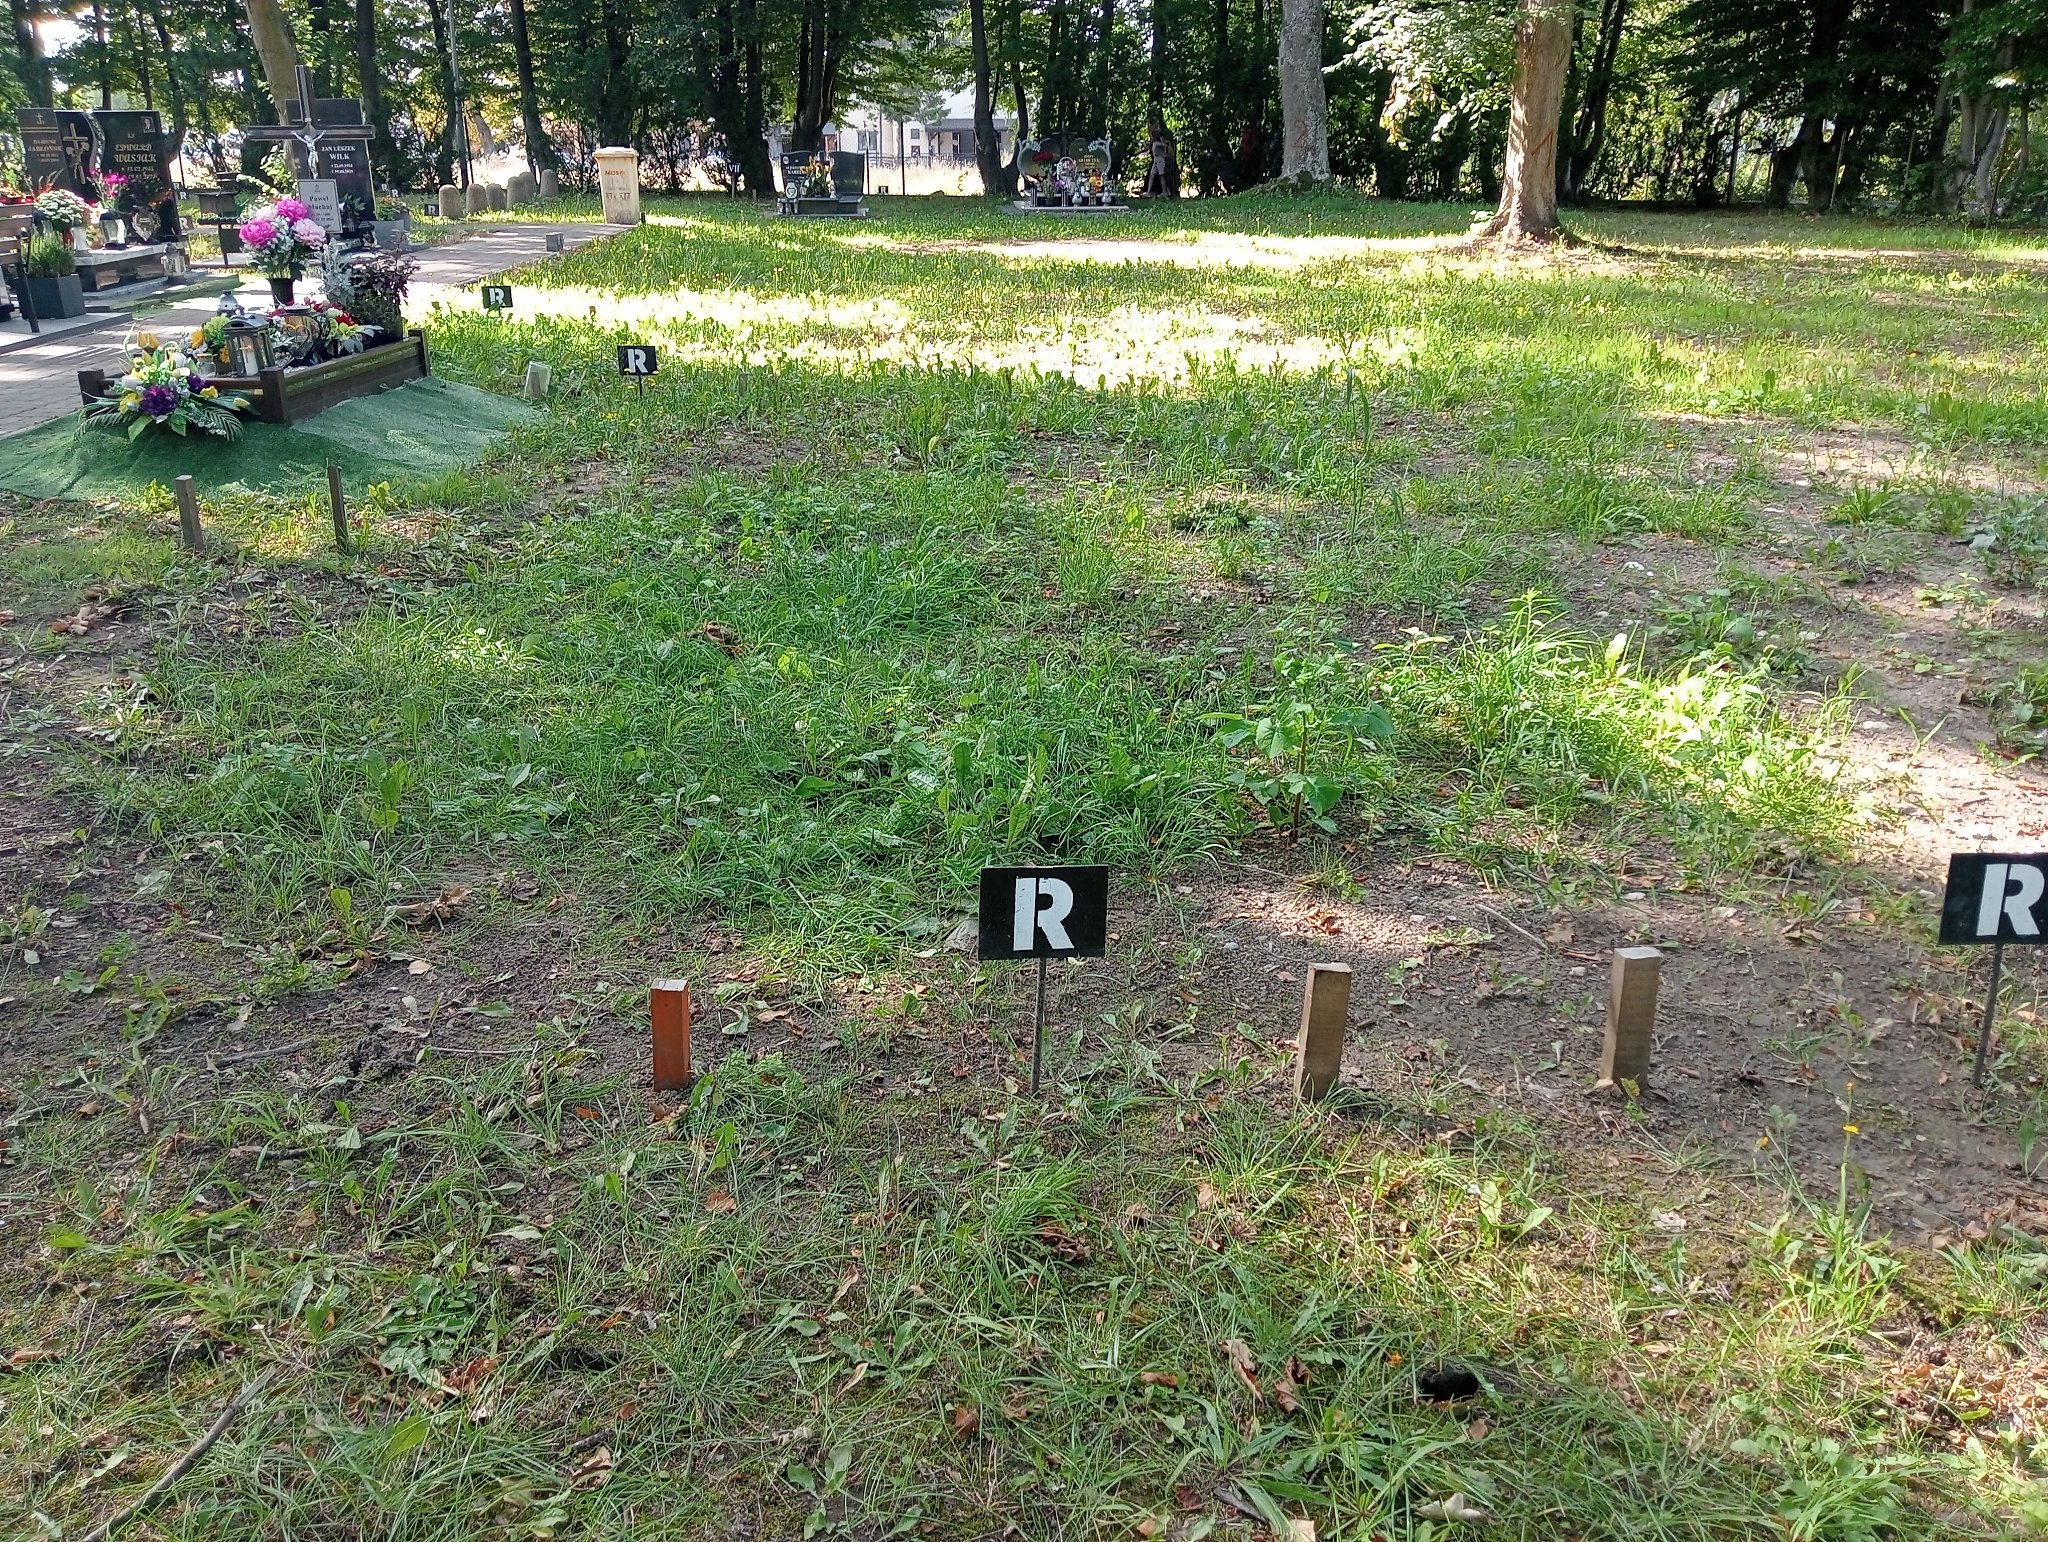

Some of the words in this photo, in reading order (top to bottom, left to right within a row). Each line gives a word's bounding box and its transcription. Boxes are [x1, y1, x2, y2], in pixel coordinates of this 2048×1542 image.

[115, 143, 152, 151] EDWARD
[728, 164, 740, 173] VII
[180, 191, 187, 199] R
[391, 190, 399, 198] R
[427, 205, 436, 215] R
[179, 217, 190, 230] R
[489, 287, 507, 306] R
[627, 348, 649, 374] R
[1976, 863, 2045, 936] R
[1013, 877, 1075, 951] R
